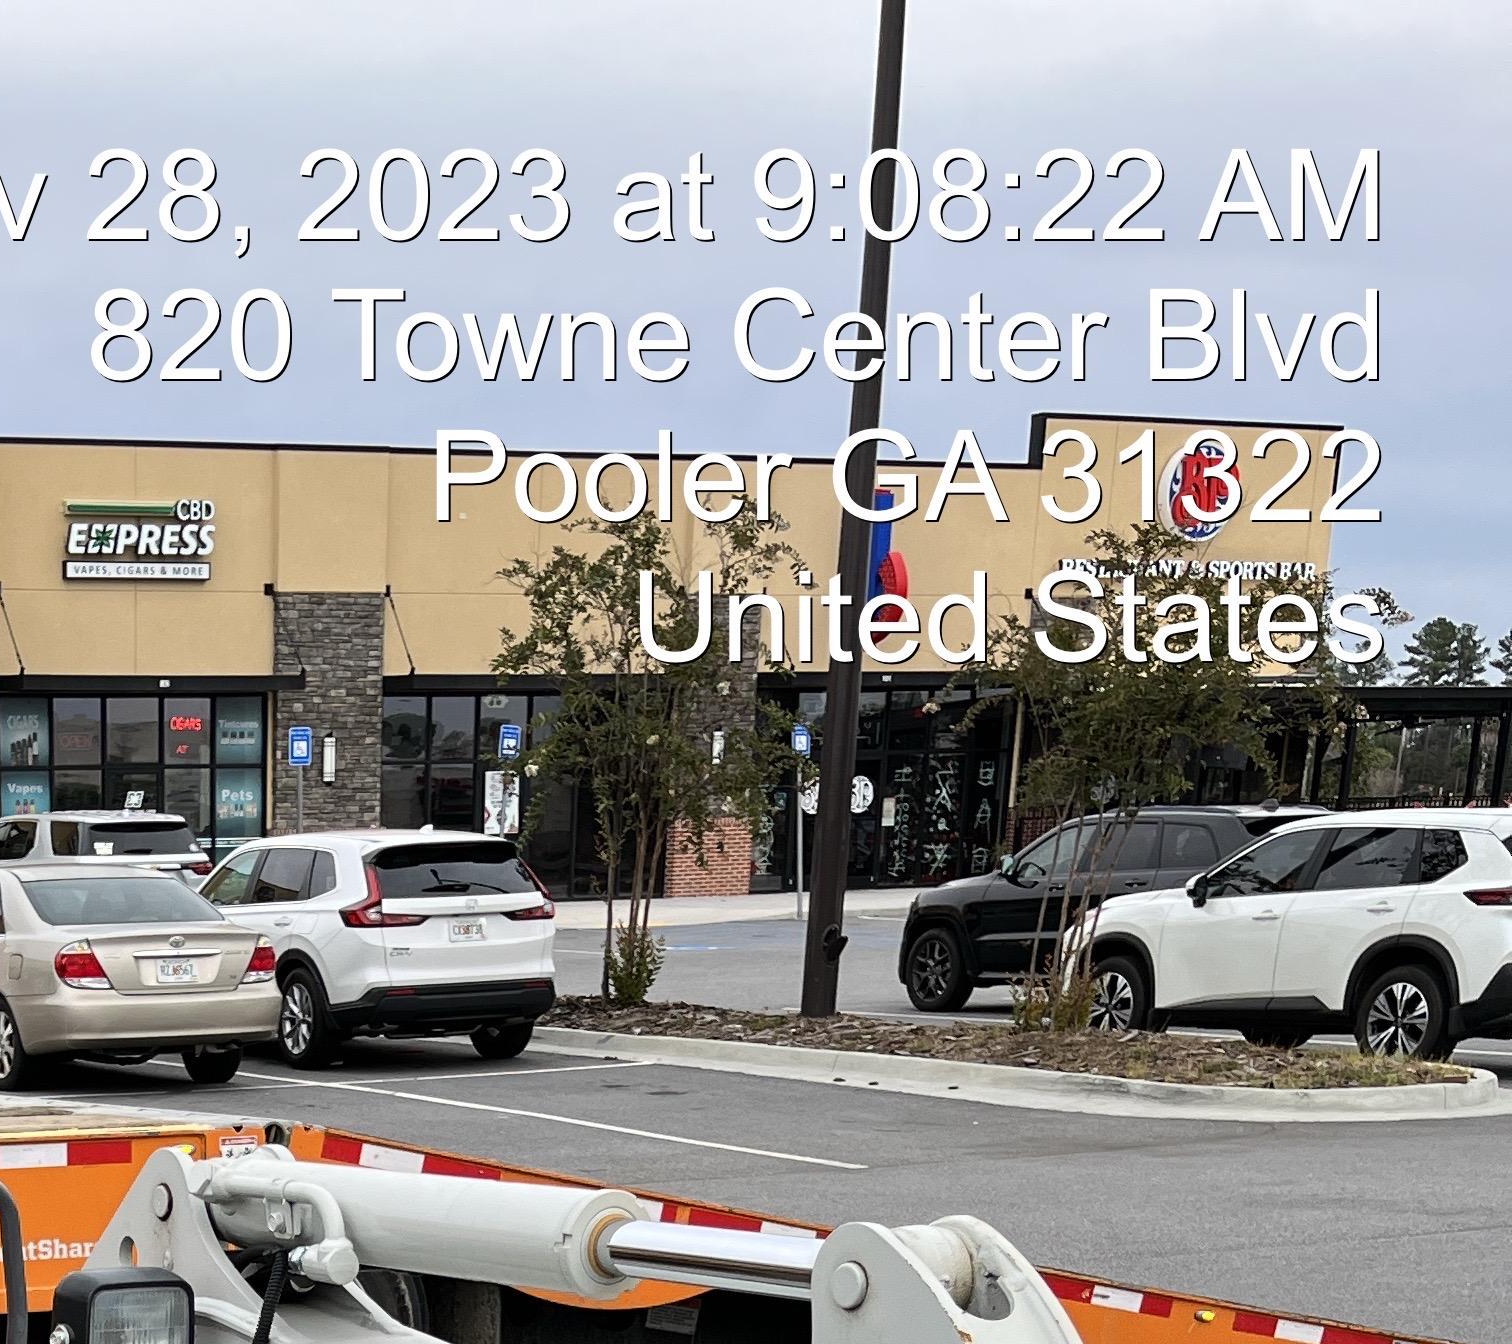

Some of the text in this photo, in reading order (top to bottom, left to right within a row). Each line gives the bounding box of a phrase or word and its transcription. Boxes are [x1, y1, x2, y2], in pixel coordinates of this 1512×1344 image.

[175, 499, 216, 522] CBD
[67, 522, 217, 556] EXPRESS
[73, 565, 112, 576] VAPES,
[115, 565, 156, 576] CIGARS
[171, 566, 204, 576] MORE
[1208, 560, 1276, 581] SPORTS
[7, 783, 44, 794] Vapes
[221, 789, 254, 802] Pets
